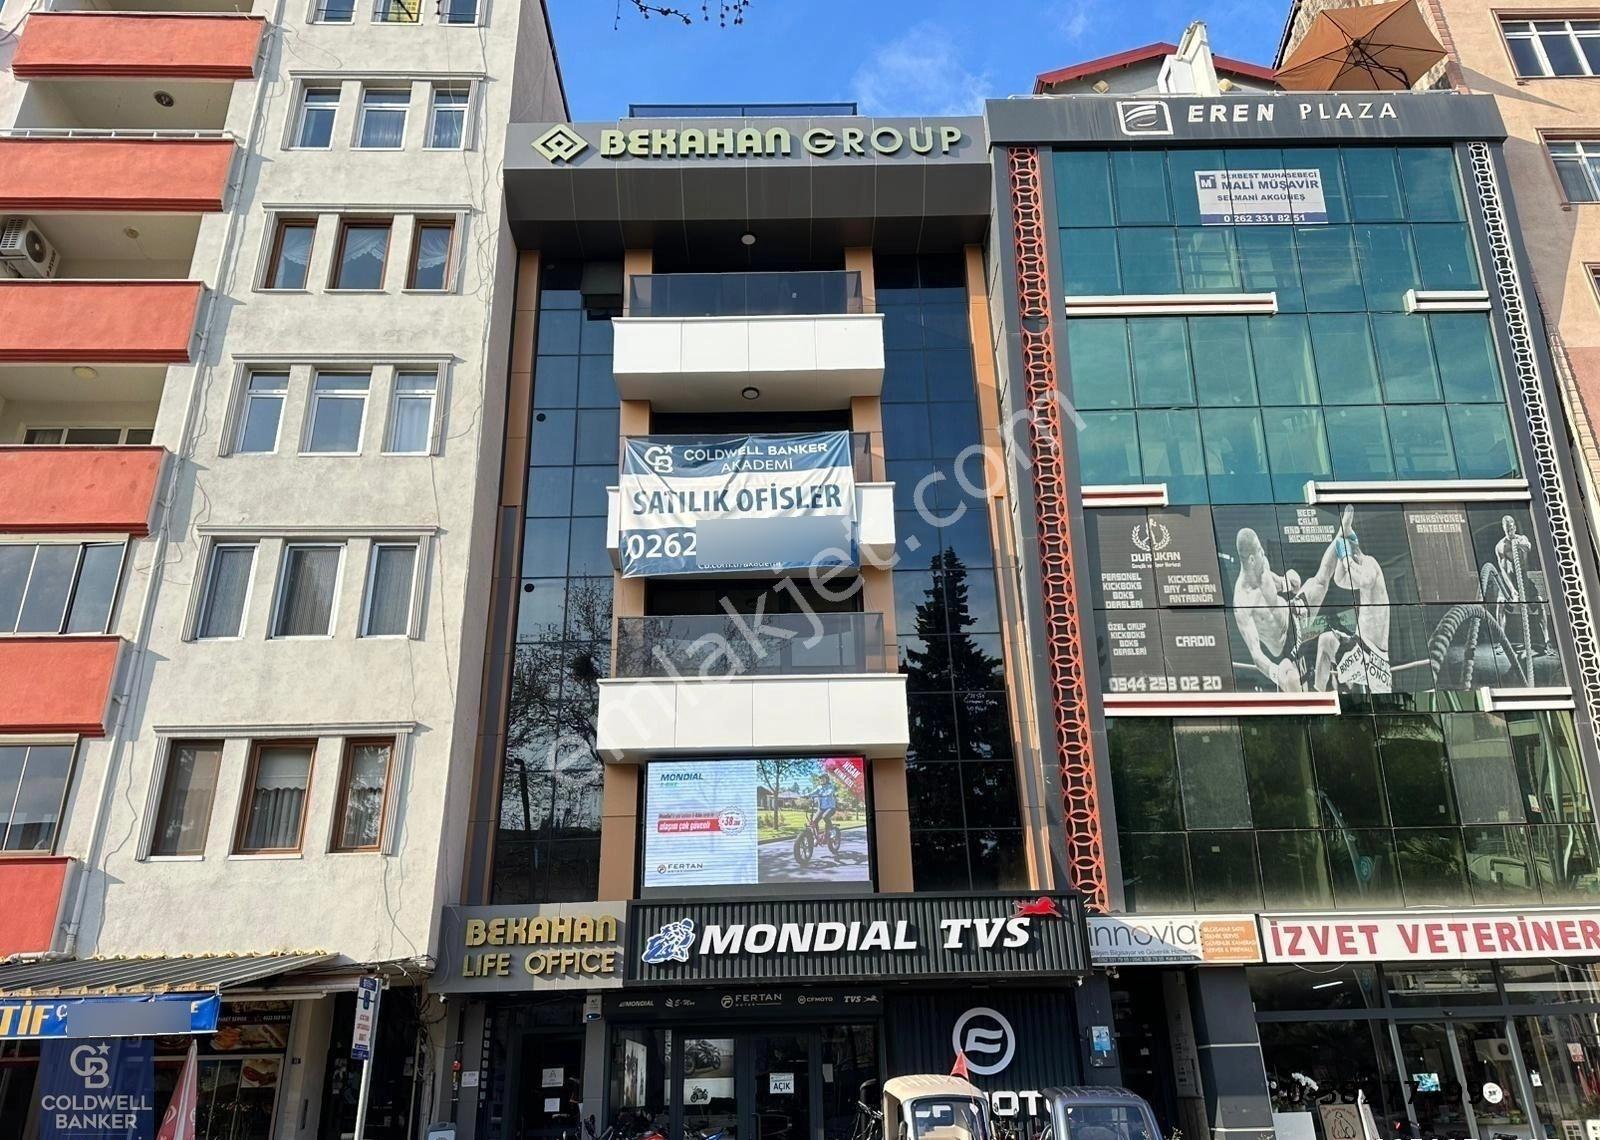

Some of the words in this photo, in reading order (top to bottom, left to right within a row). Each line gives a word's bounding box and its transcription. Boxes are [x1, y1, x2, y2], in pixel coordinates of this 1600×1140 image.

[1188, 104, 1275, 122] EREN
[1300, 103, 1398, 120] PLAZA
[600, 128, 791, 157] BEKAHAN
[803, 126, 962, 155] GROUP
[1261, 171, 1317, 179] MUHASEBECİ
[1222, 180, 1254, 190] MALİ
[1258, 179, 1319, 191] MÜŞAVİR
[1217, 193, 1258, 201] SELMANİ
[684, 446, 760, 462] COLDWELL
[768, 442, 828, 456] BANKER
[721, 458, 793, 474] AKADEMİ
[633, 487, 730, 516] SATILIK
[736, 482, 842, 512] OFİSLER
[1296, 509, 1316, 517] KEEP
[1131, 551, 1181, 562] DURUKAN
[1101, 573, 1142, 581] PERSONEL
[1167, 574, 1209, 584] KICKBOKS
[1103, 582, 1143, 590] KICKBOKS
[1163, 585, 1181, 593] BAY
[1187, 584, 1216, 593] BAYAN
[1112, 591, 1135, 599] BOKS
[1105, 598, 1144, 609] DERSLERİ
[1107, 621, 1126, 631] ÖZEL
[1110, 631, 1146, 639] KICKBOKS
[1119, 640, 1139, 648] BOKS
[1175, 635, 1216, 647] CARDIO
[1113, 646, 1147, 656] DERSLERİ
[1109, 677, 1146, 692] 0544
[1180, 676, 1200, 691] 02
[1202, 675, 1222, 691] 20
[661, 773, 704, 781] MONDIAL
[465, 915, 617, 946] BEKAHAN
[1088, 921, 1197, 947] innovia
[1270, 920, 1379, 956] İZVET
[1396, 915, 1600, 955] VETERİNER
[699, 920, 918, 955] MONDIAL
[940, 917, 1030, 949] TVS
[462, 953, 511, 977] LIFE
[524, 950, 615, 975] OFFICE
[735, 993, 782, 1002] FERTAN
[844, 995, 861, 1003] TVS
[773, 1082, 791, 1092] AÇIK
